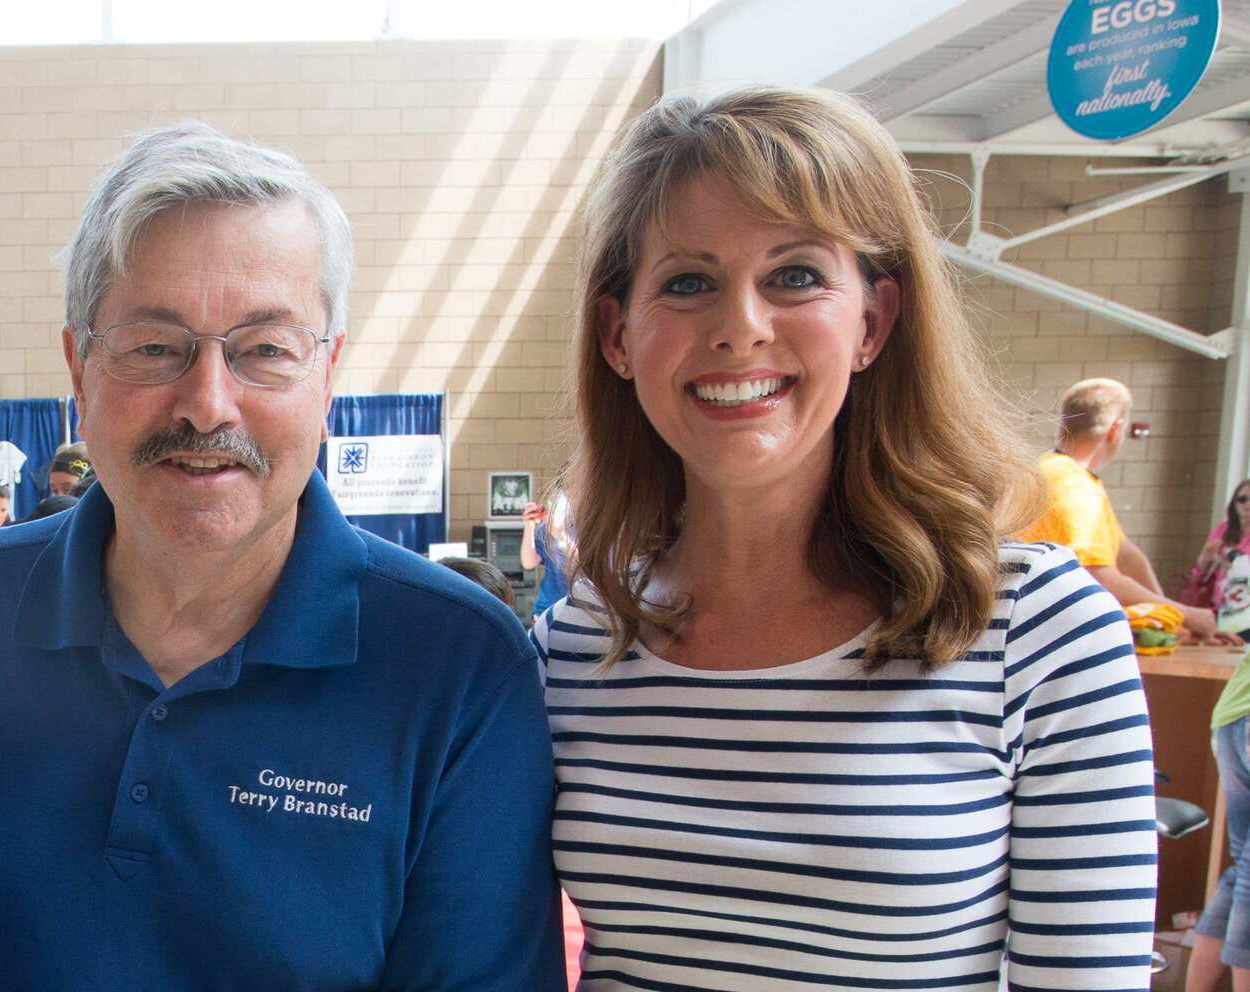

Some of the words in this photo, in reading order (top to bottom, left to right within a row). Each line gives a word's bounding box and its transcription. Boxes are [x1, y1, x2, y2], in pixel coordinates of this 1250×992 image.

[1088, 25, 1149, 51] produced
[1152, 24, 1164, 35] in
[1167, 15, 1199, 31] Iowa
[1091, 0, 1176, 34] EGGS
[1073, 55, 1103, 71] each
[1138, 36, 1188, 55] ranking
[1104, 60, 1150, 97] first
[342, 478, 355, 487] All
[357, 478, 396, 488] proceeds
[398, 476, 428, 486] benefit
[258, 769, 348, 797] Governor
[229, 785, 279, 812] Terry
[284, 794, 372, 823] Branstad
